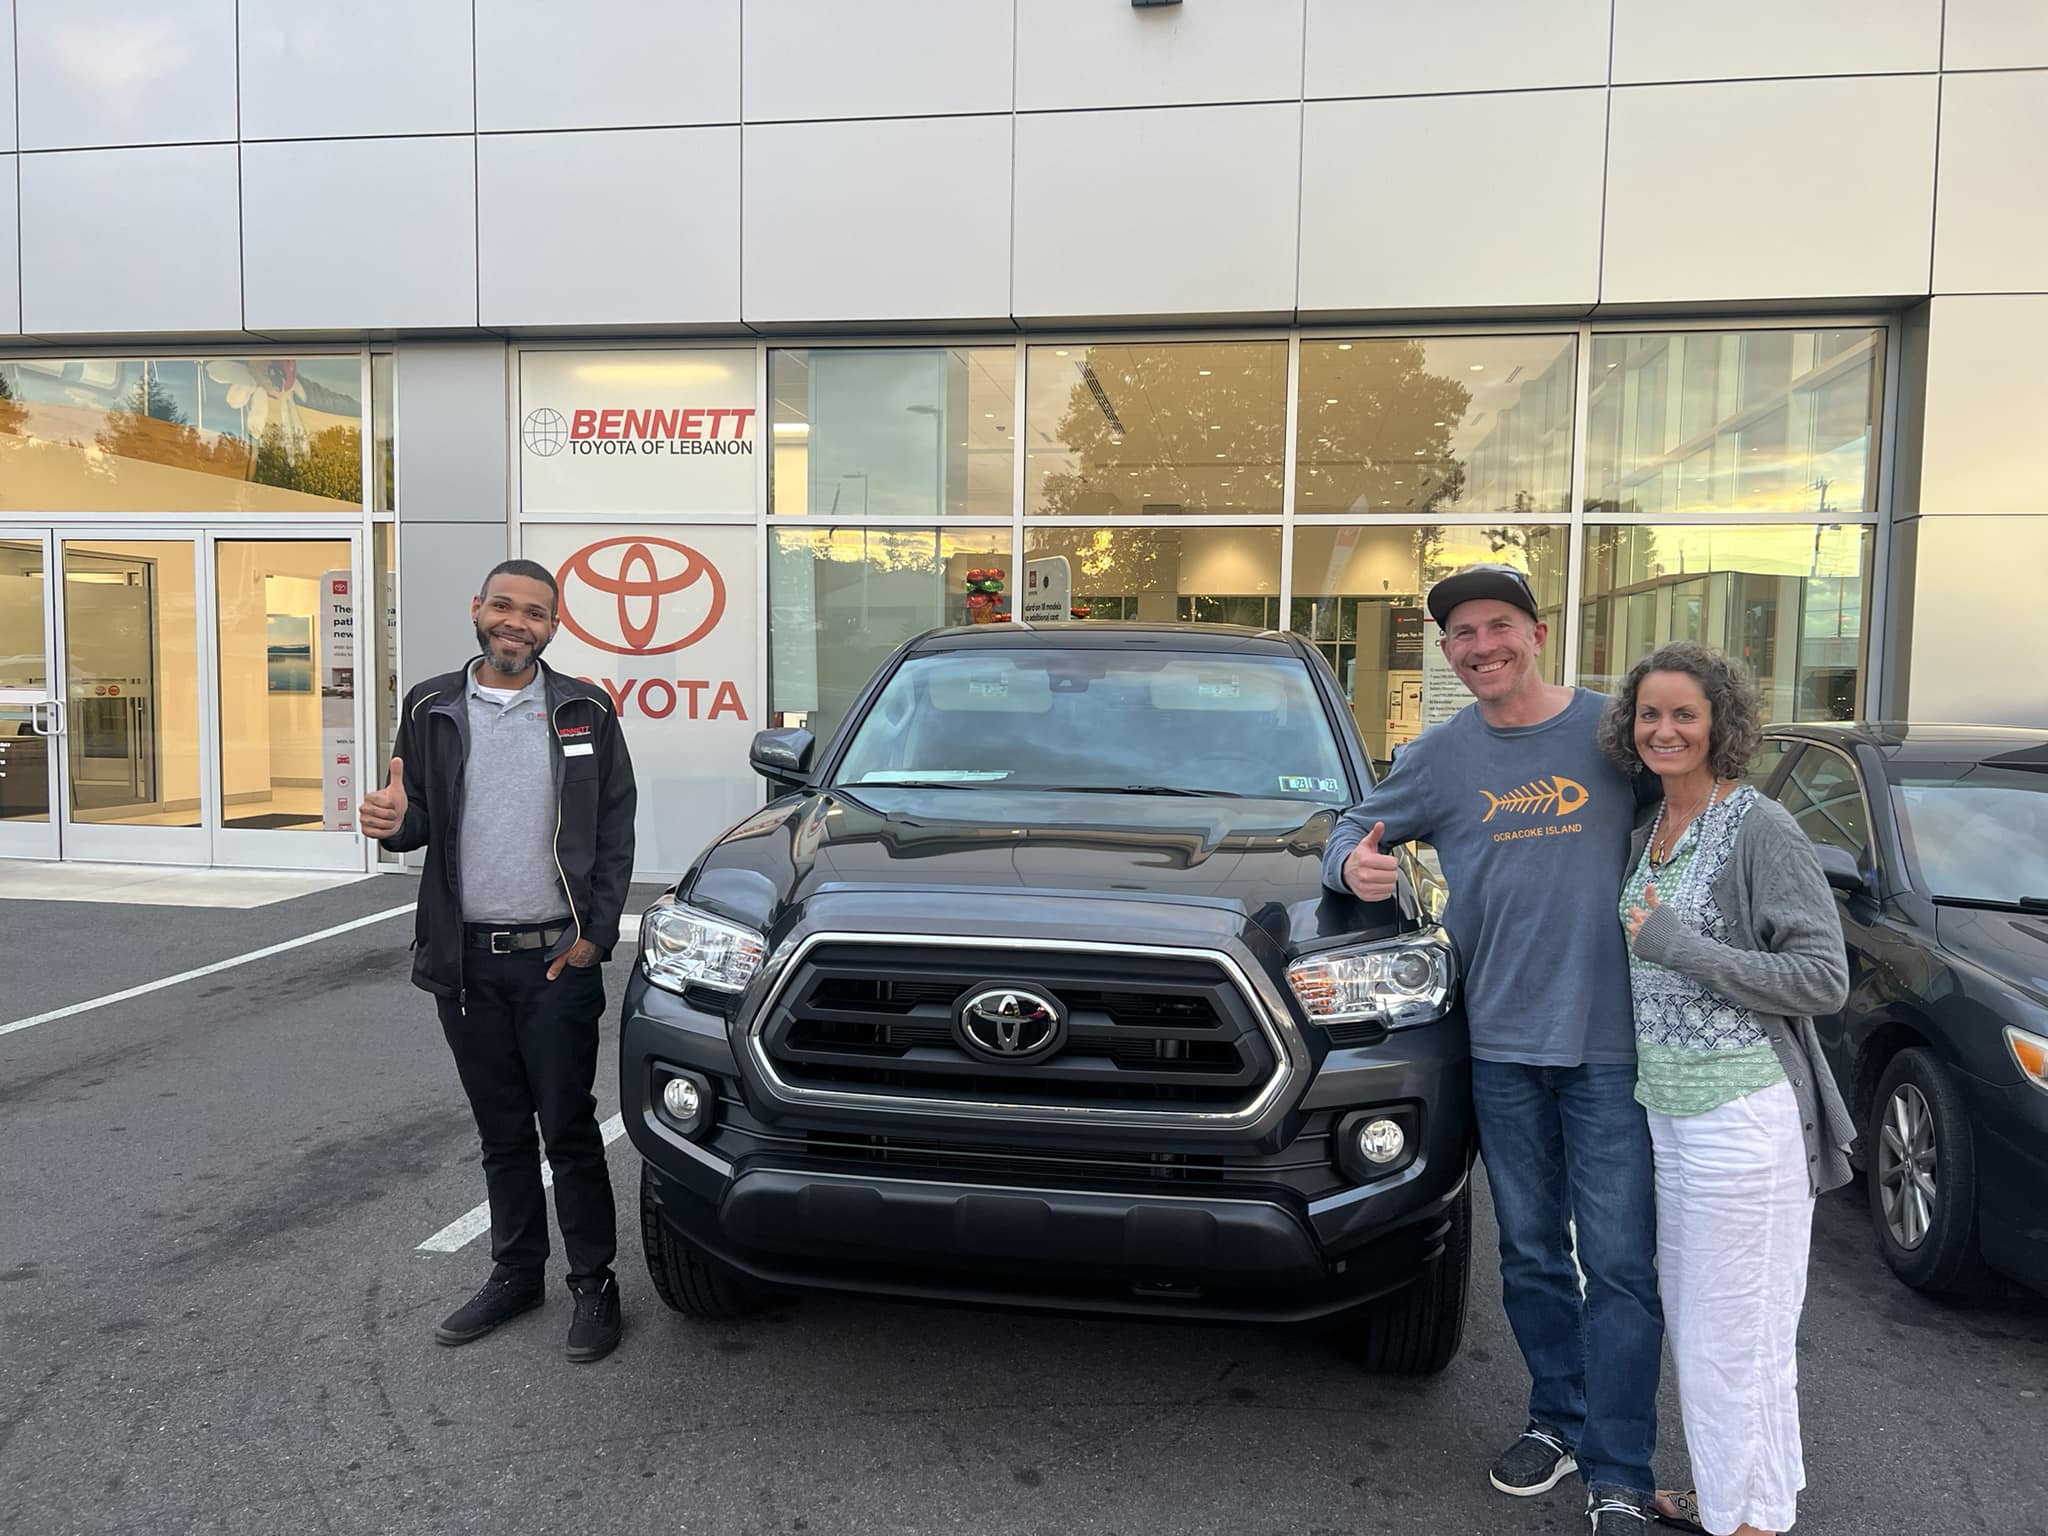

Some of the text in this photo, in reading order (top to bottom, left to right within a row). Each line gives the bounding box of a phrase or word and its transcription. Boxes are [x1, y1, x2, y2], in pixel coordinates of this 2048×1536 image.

[570, 408, 756, 440] BENNETT
[569, 440, 753, 455] TOYOTA OF LEBANON
[332, 604, 353, 613] The
[576, 676, 748, 720] YOTA
[1493, 823, 1582, 842] OCRACOKE ISLAND
